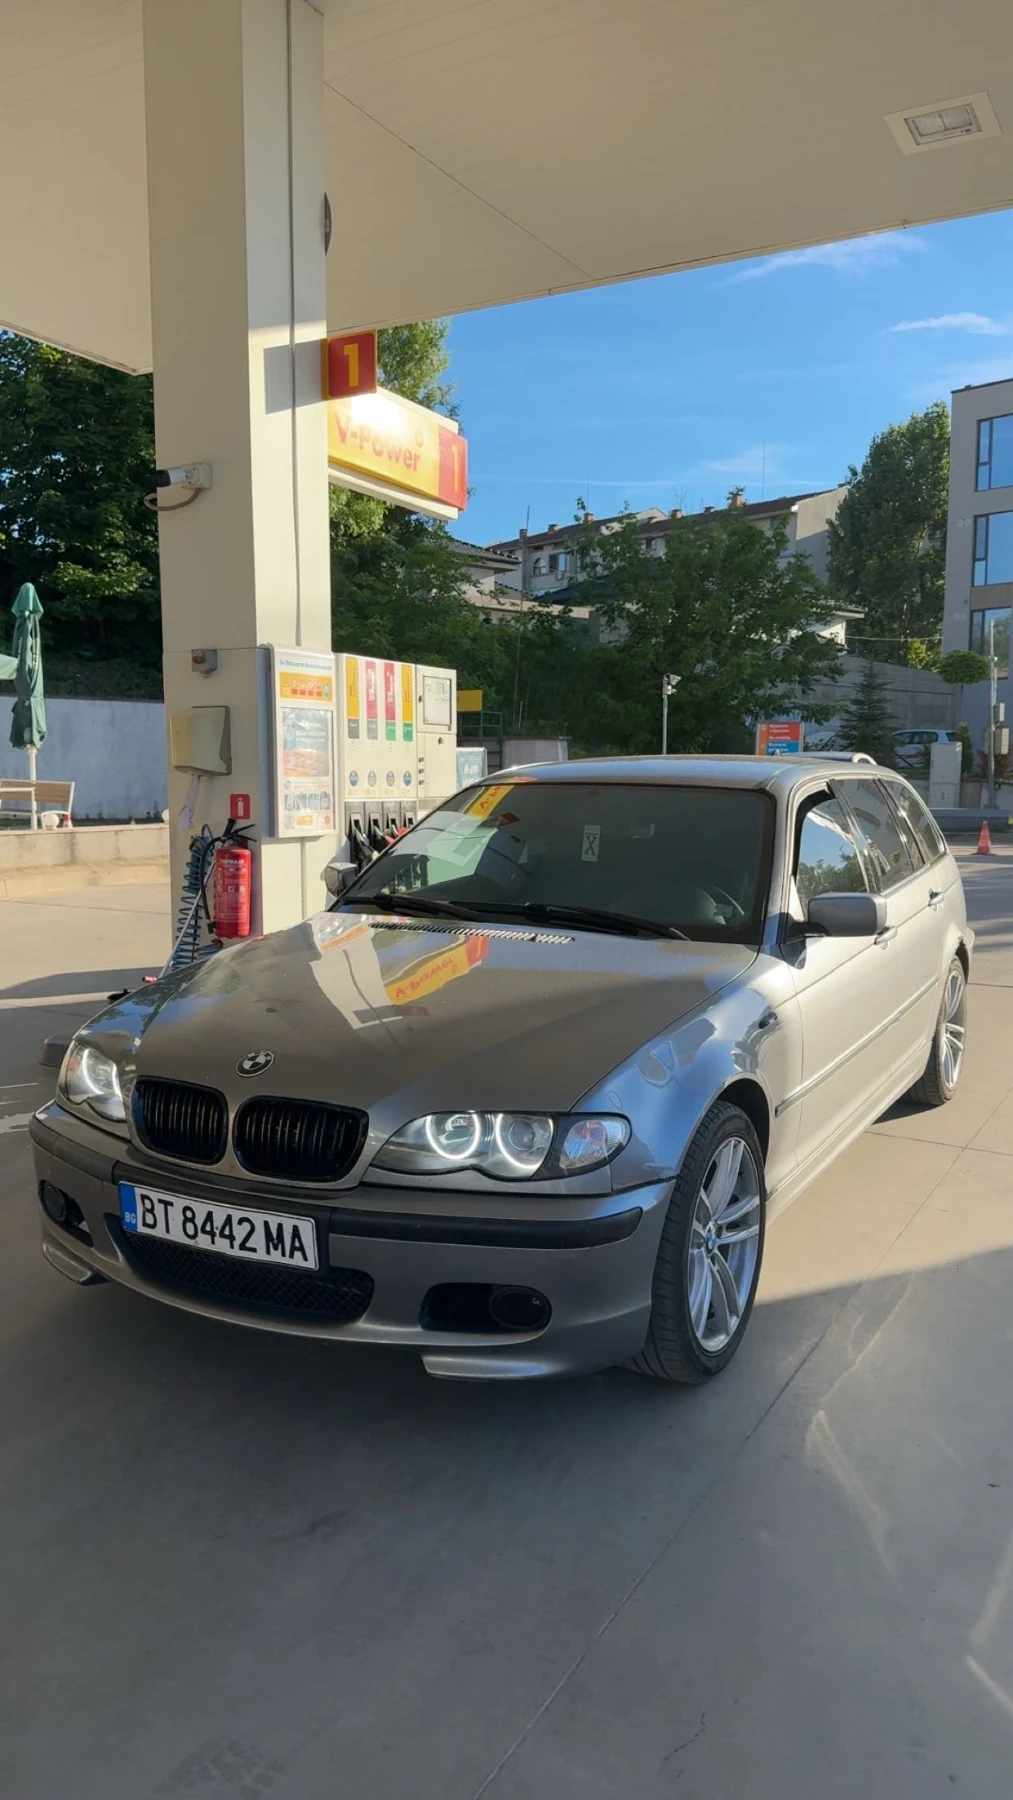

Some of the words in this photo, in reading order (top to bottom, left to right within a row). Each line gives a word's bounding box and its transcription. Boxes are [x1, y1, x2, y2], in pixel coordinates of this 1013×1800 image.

[344, 343, 359, 388] 1
[451, 443, 459, 493] 1
[124, 1212, 137, 1224] BG
[140, 1194, 174, 1234] BT
[181, 1205, 257, 1254] 8442
[263, 1219, 309, 1262] MA
